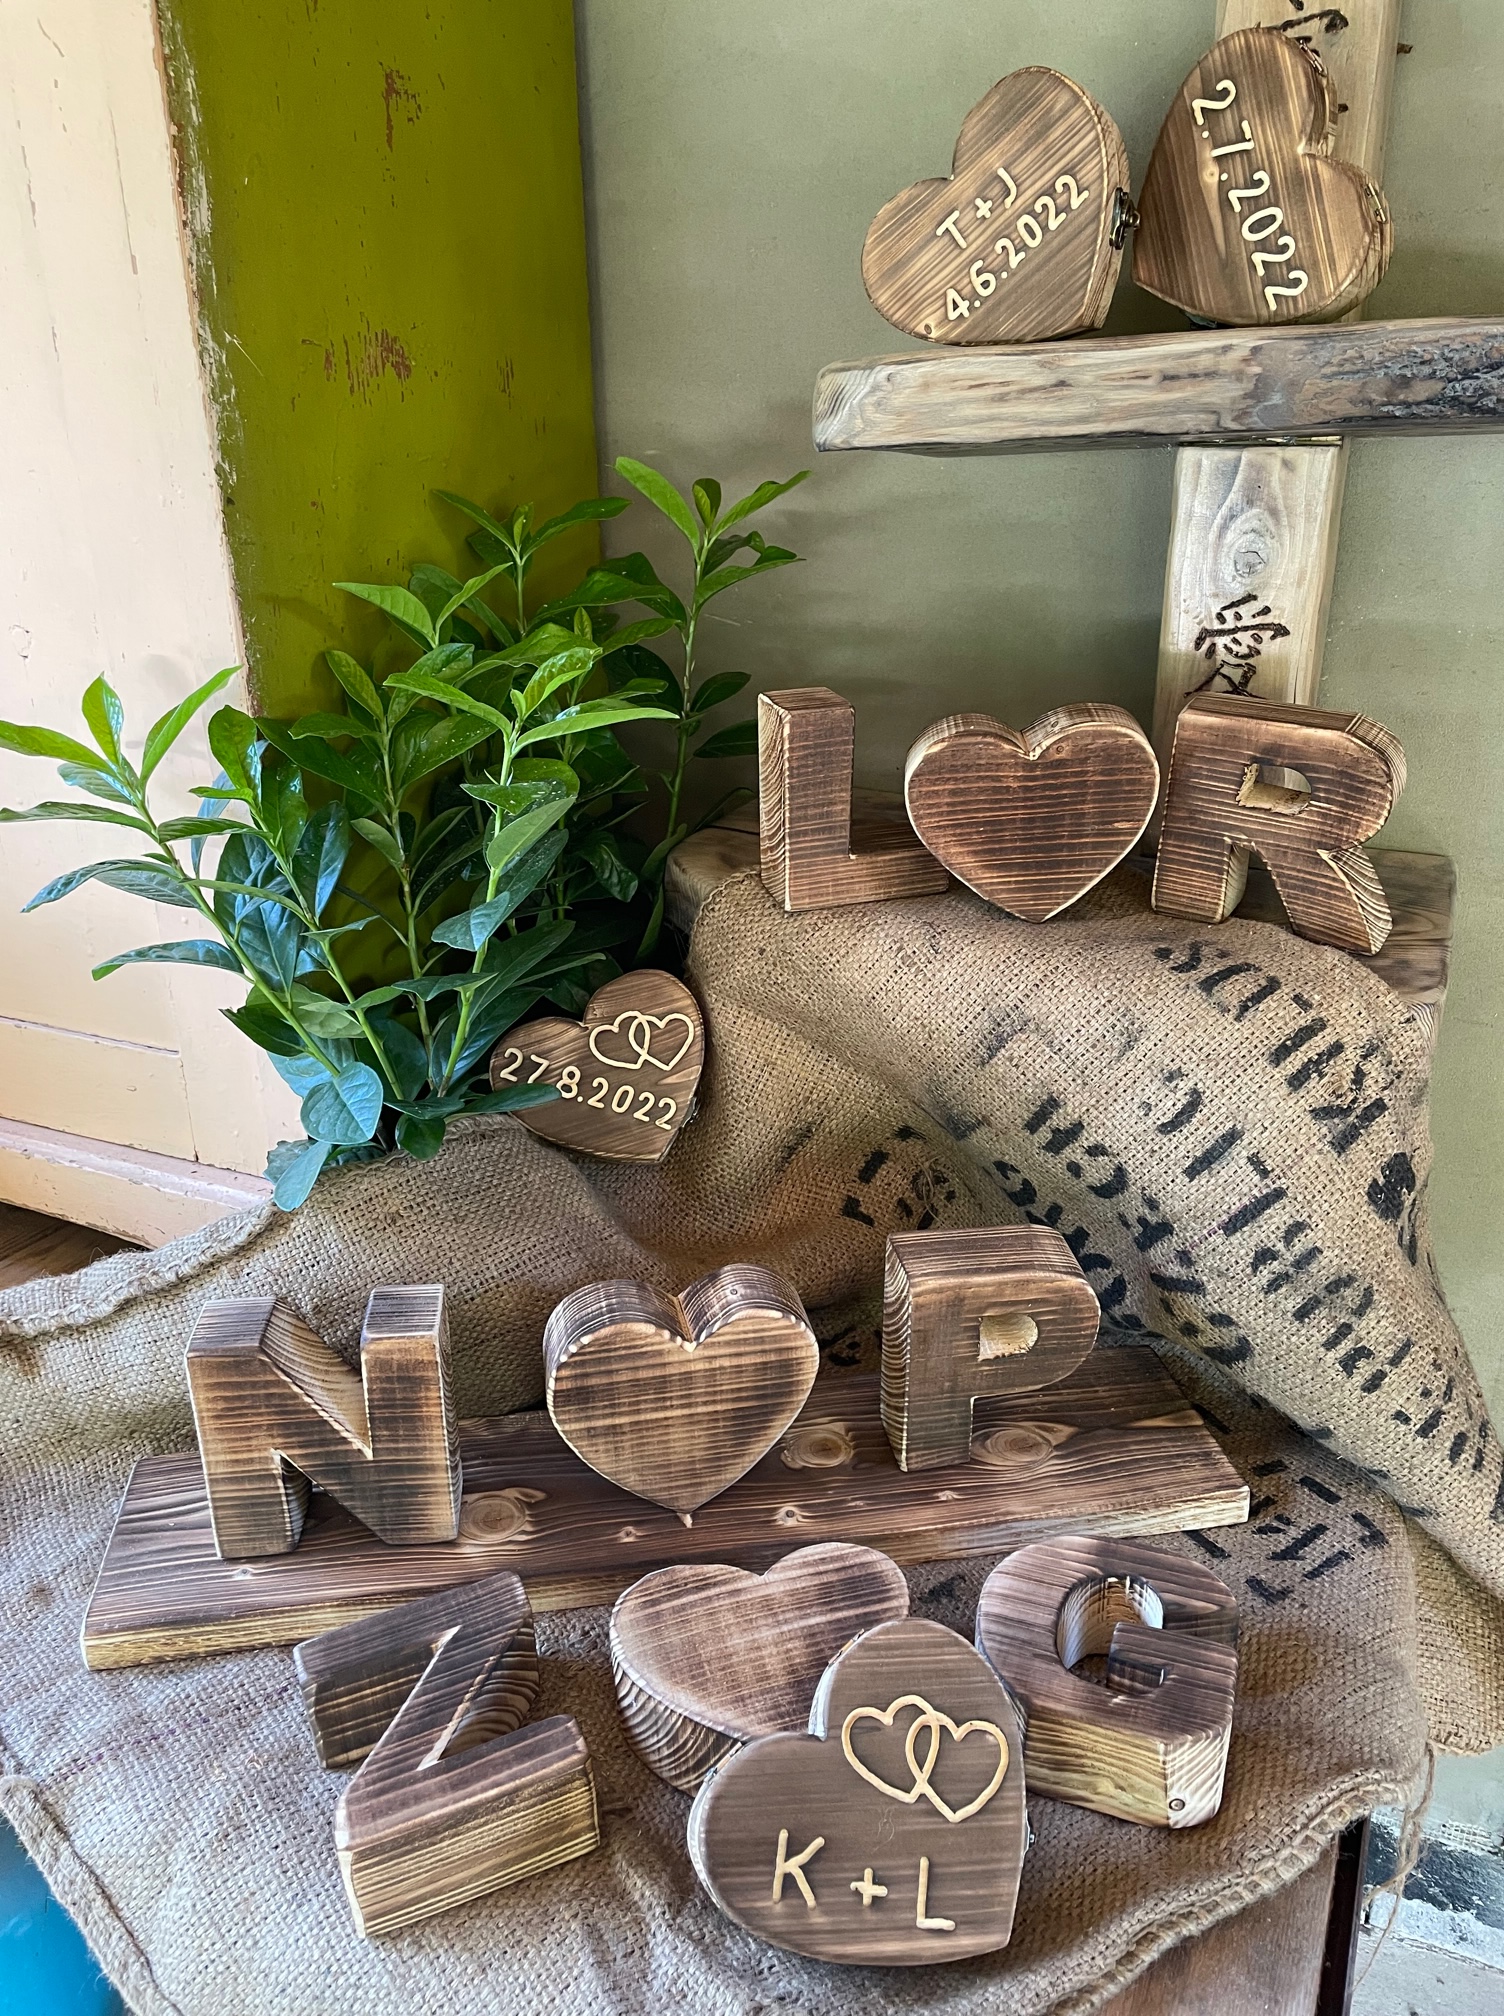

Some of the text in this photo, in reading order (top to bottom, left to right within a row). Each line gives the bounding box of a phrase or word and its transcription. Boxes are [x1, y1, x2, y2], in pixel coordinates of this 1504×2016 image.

[944, 174, 1090, 321] 4.6.2022
[757, 686, 1407, 955] L R
[499, 1047, 678, 1131] 278.2022
[185, 1283, 463, 1560] N
[881, 1223, 1101, 1472] P
[294, 1535, 1239, 1938] Z G
